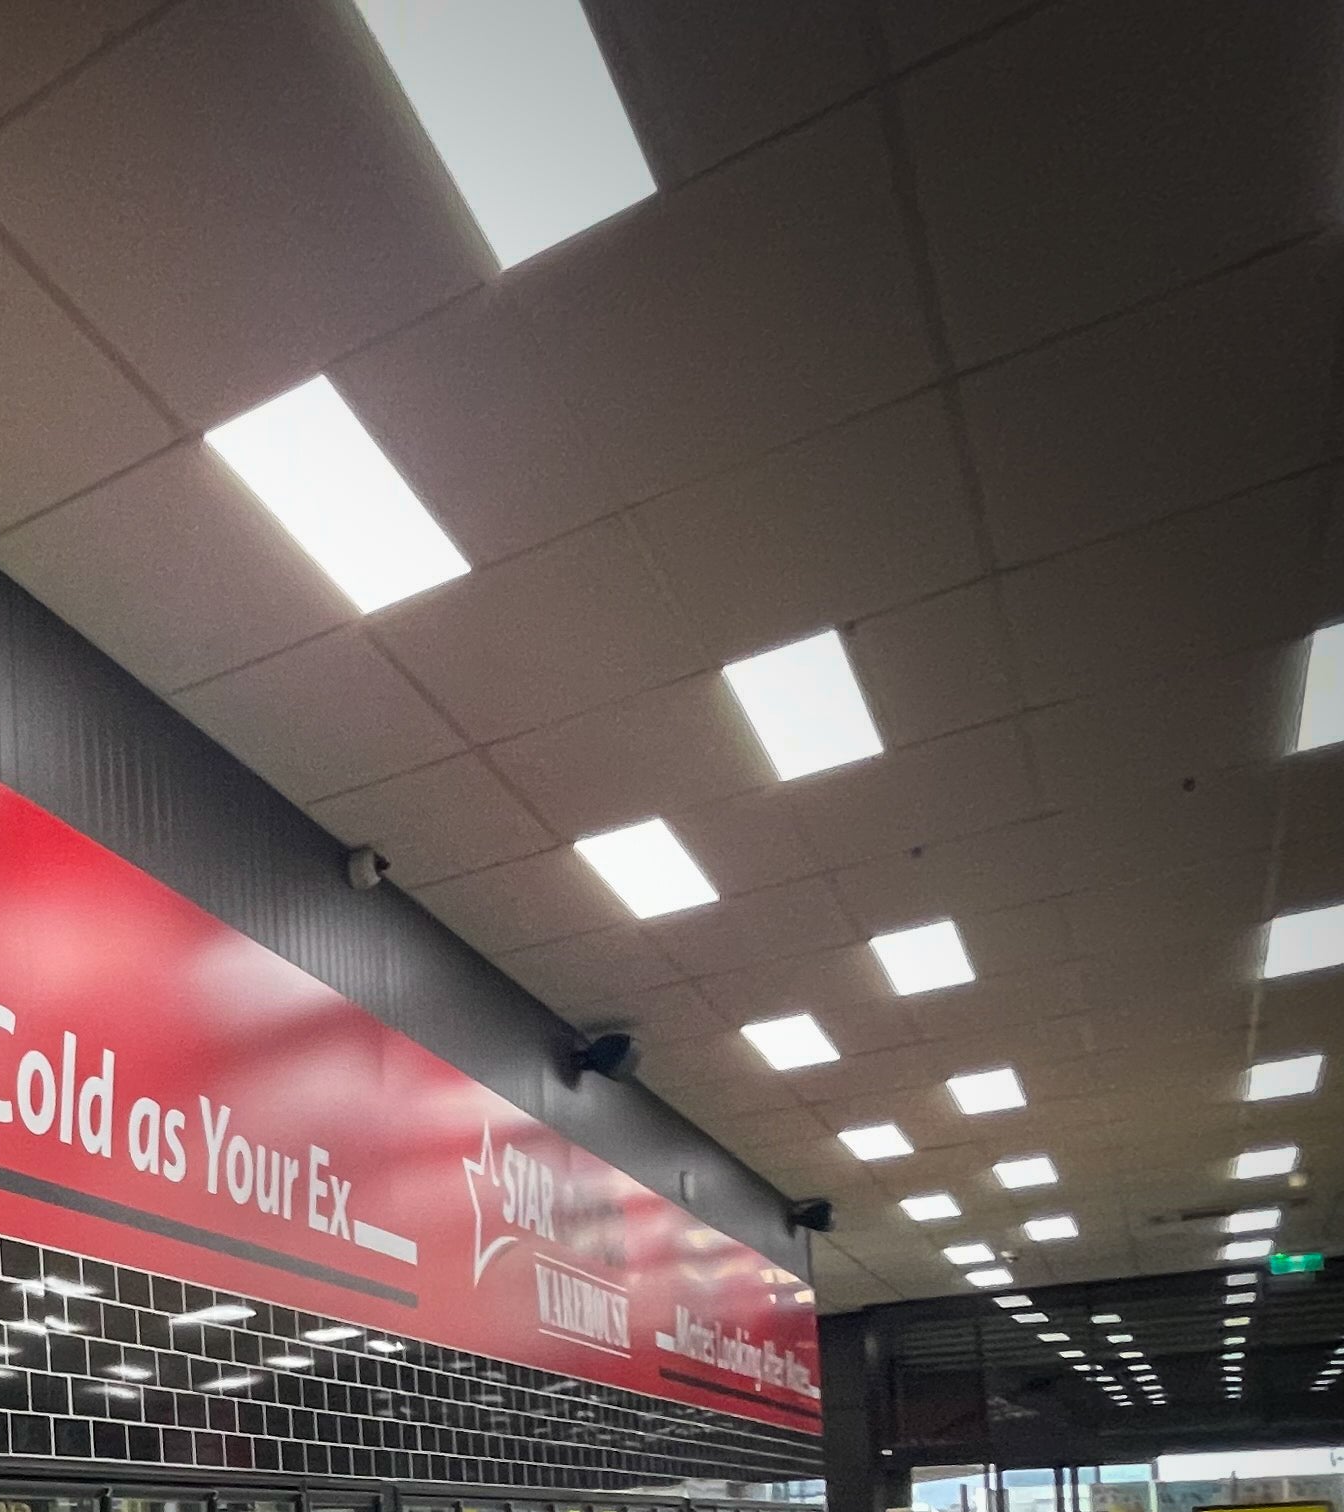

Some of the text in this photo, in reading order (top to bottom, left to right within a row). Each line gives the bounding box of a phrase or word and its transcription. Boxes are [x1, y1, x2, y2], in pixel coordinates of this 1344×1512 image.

[128, 1097, 186, 1183] as
[199, 1095, 300, 1218] Your
[308, 1144, 353, 1243] Ex
[502, 1142, 556, 1241] STAR
